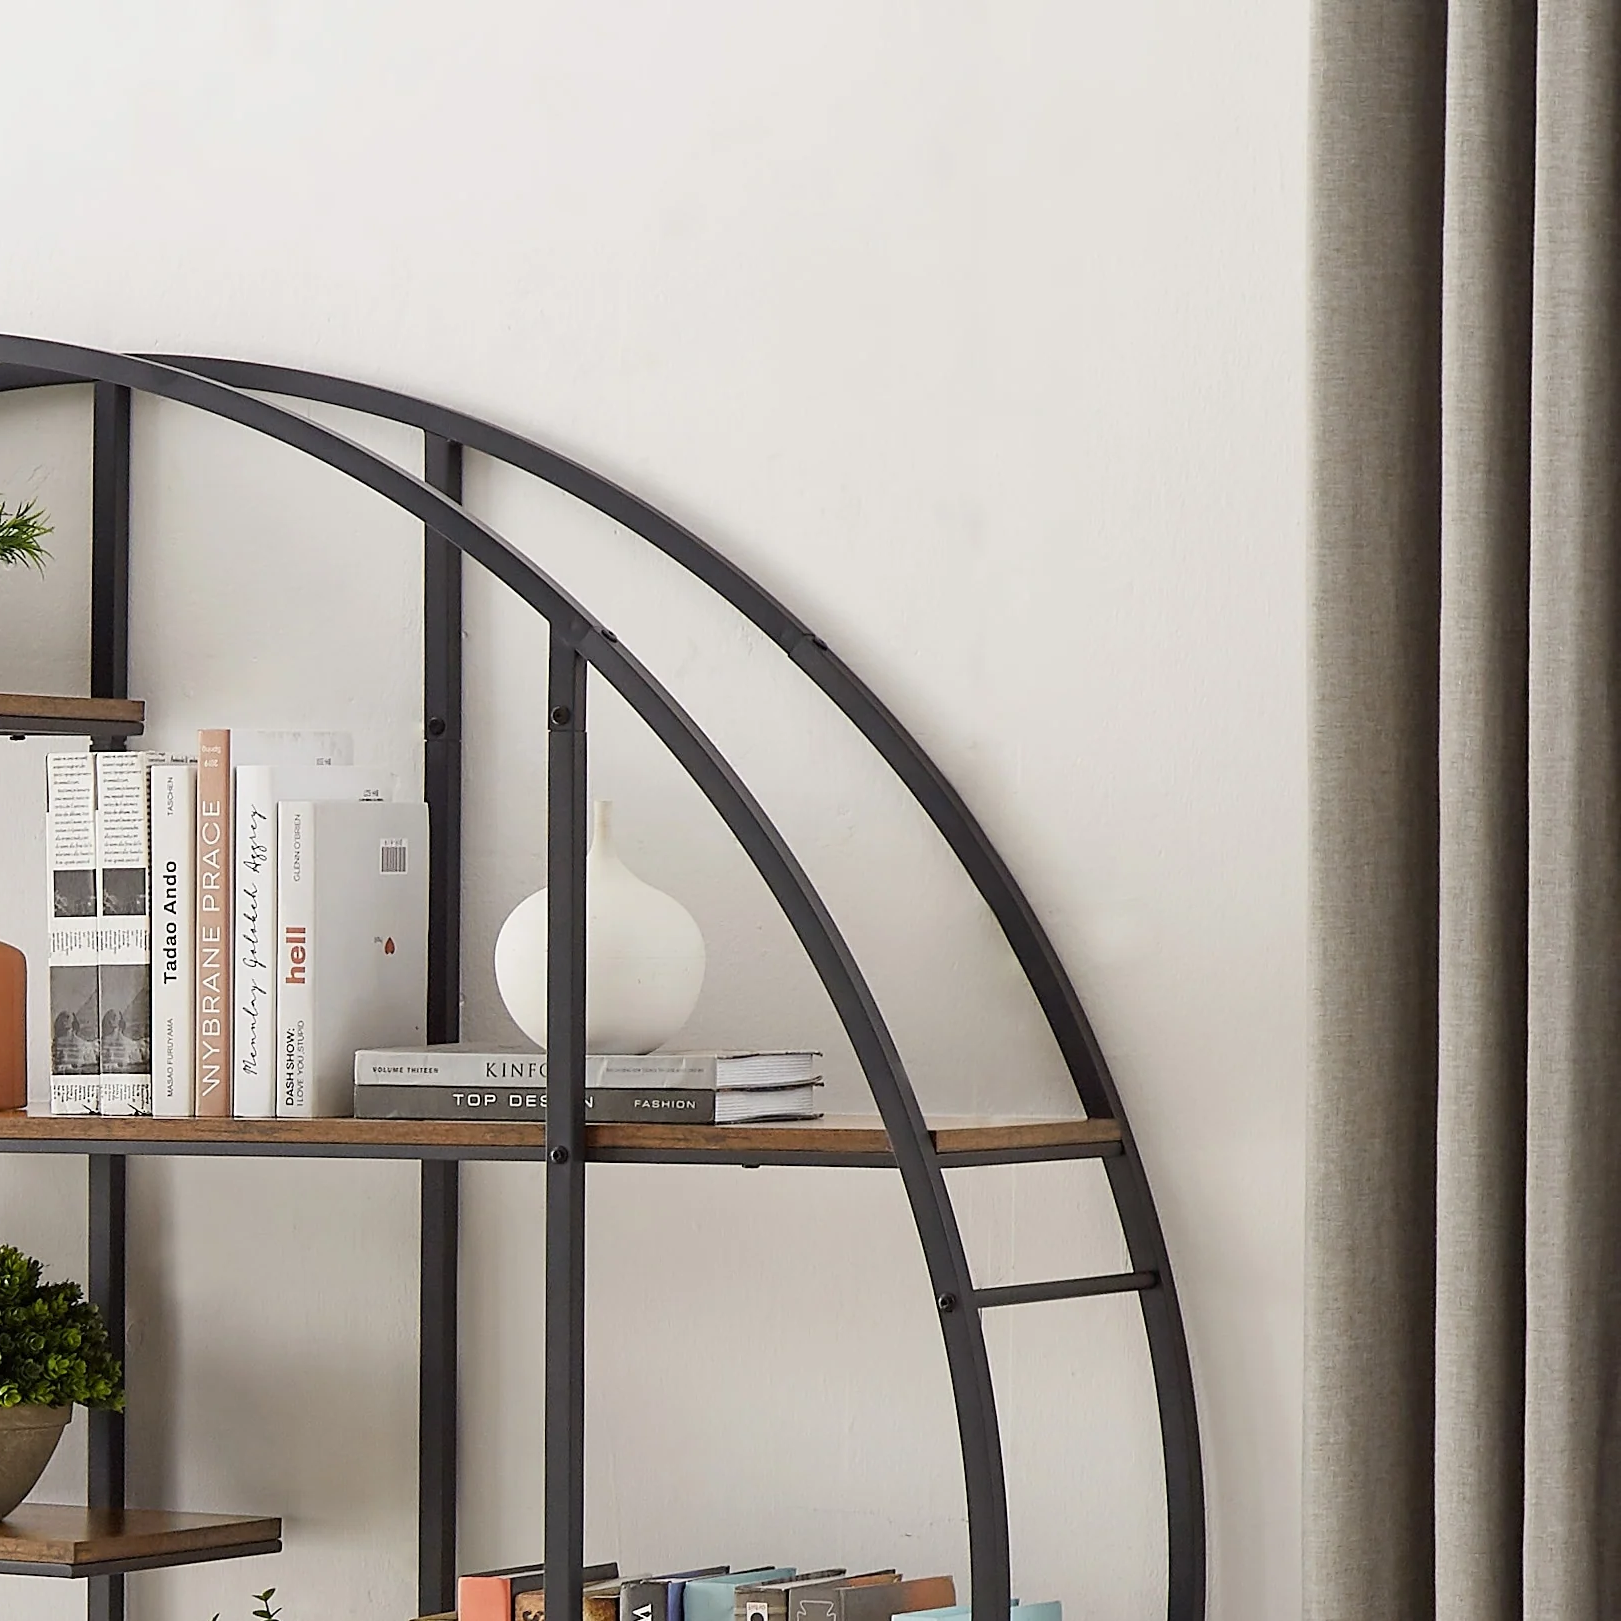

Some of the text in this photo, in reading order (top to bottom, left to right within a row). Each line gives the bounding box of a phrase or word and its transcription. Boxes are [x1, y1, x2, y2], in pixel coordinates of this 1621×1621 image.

[166, 777, 174, 816] TASCHEN
[163, 860, 177, 985] Tadao Ando
[202, 800, 221, 1096] WYBRANE PRACE
[285, 927, 306, 985] hell
[166, 1018, 174, 1098] MASAO FURUYAMA
[285, 1028, 295, 1106] DASH SHOW:
[373, 1066, 404, 1074] VOLUME
[452, 1093, 497, 1108] TOP
[633, 1099, 696, 1110] FASHION
